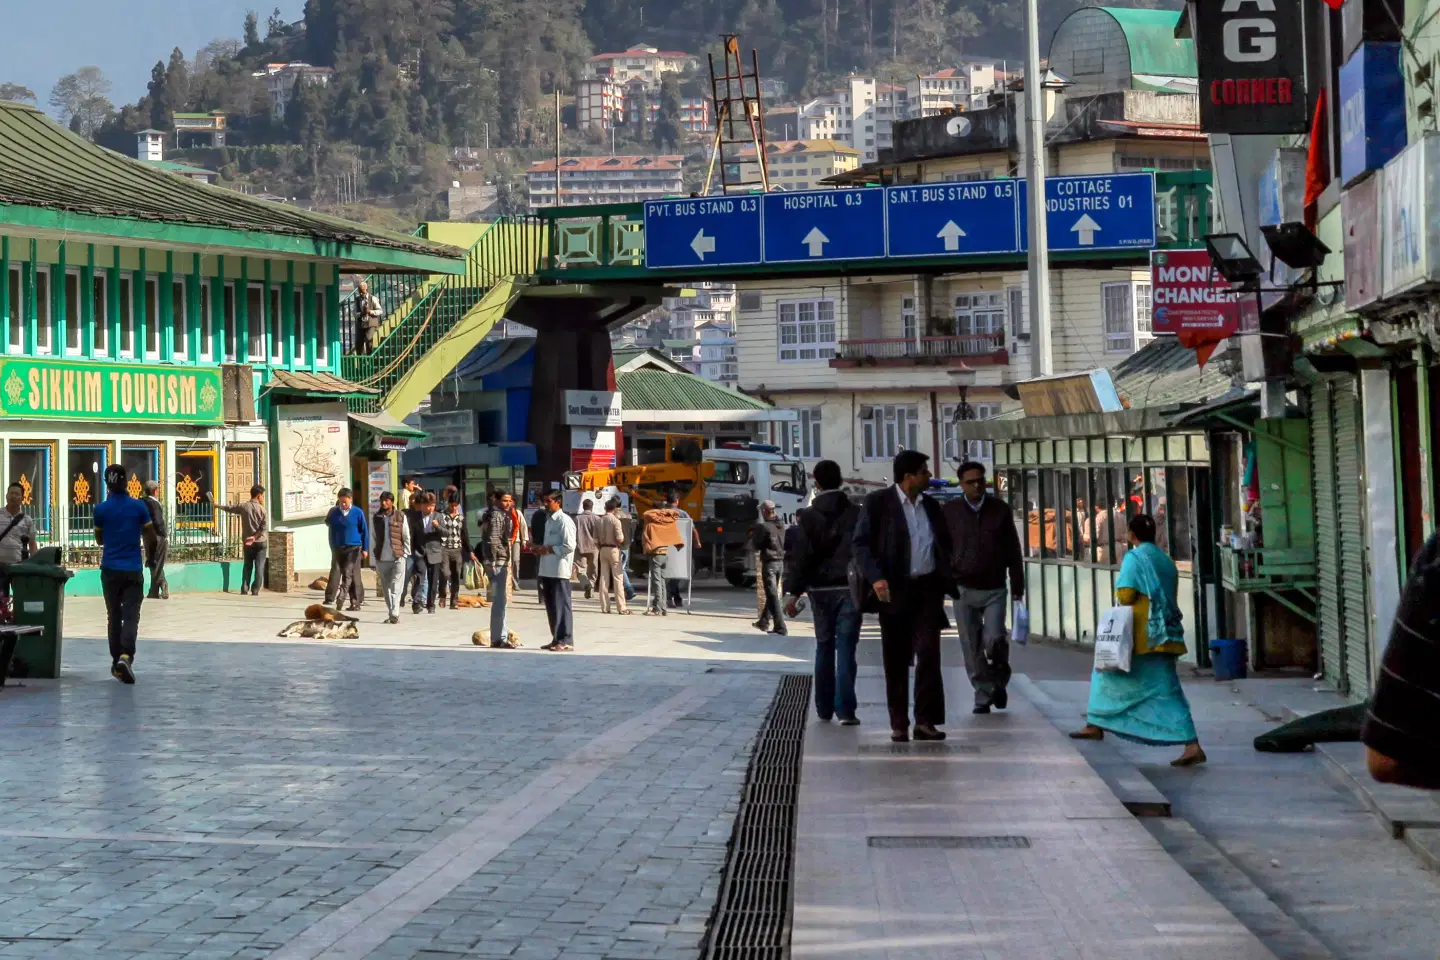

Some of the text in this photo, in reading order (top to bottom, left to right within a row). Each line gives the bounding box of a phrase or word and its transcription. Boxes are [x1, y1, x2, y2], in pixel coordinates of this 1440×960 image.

[1210, 78, 1293, 105] CORNER
[891, 185, 1012, 204] S.N.T. BUS STAND 0.5
[1057, 180, 1112, 196] COTTAGE
[649, 199, 757, 217] PVT. BUS STAND 0.3
[784, 193, 862, 210] HOSPITAL 0.3
[1045, 195, 1133, 212] NDUSTRIES 01
[1159, 266, 1227, 282] MONE
[28, 367, 197, 415] SIKKIM TOURISM
